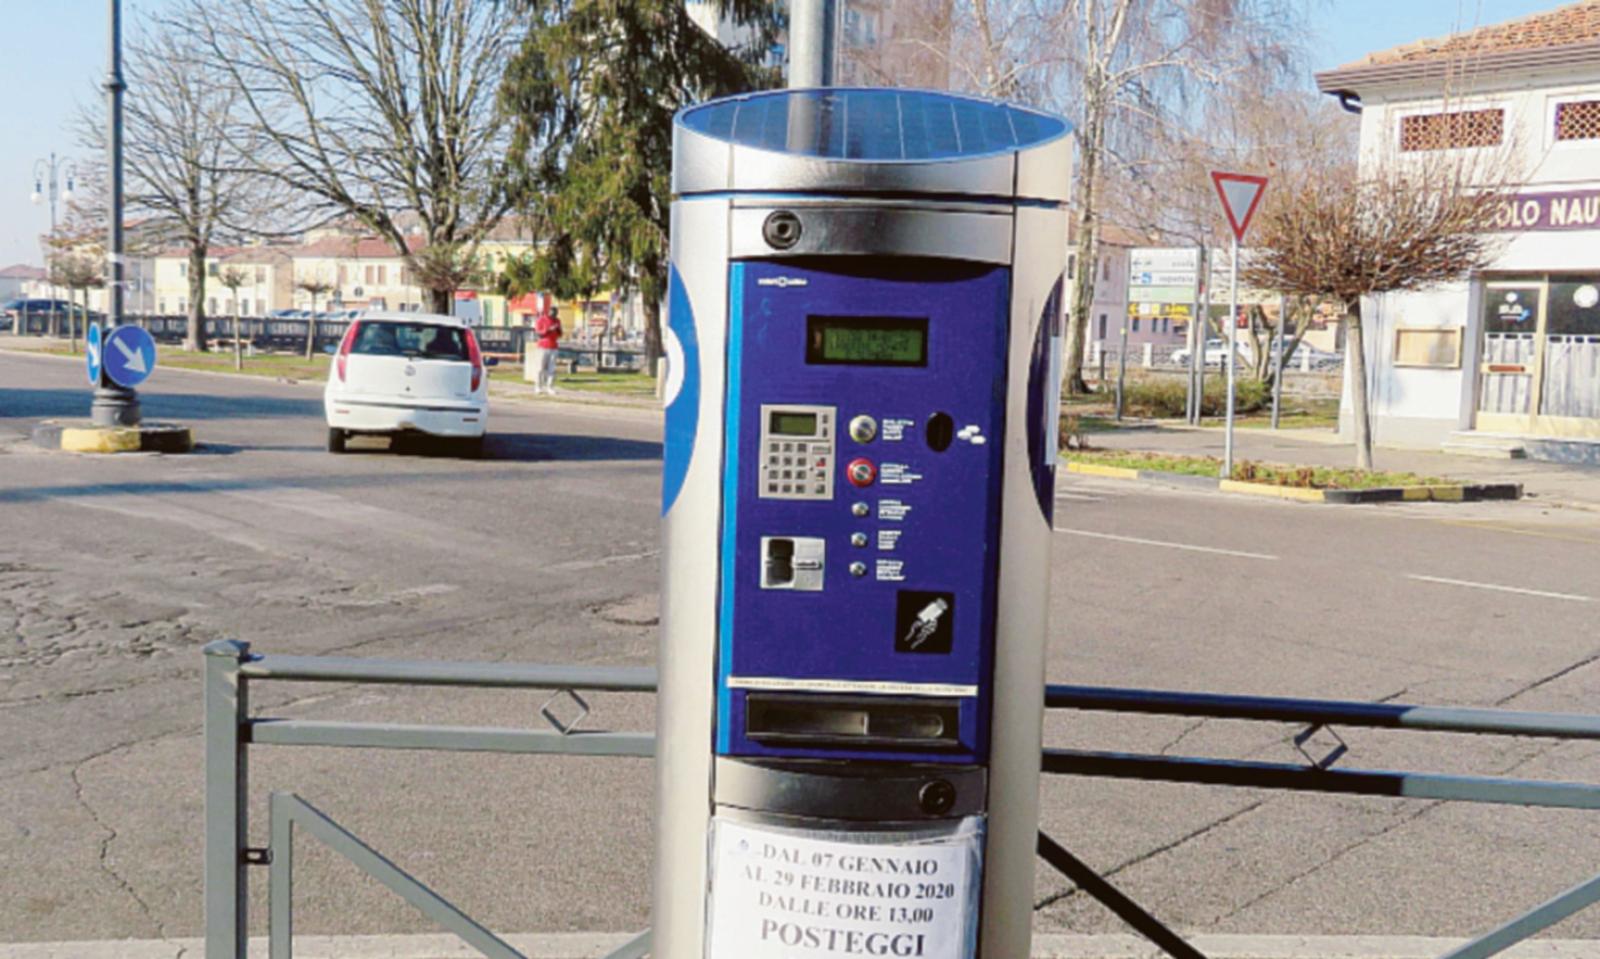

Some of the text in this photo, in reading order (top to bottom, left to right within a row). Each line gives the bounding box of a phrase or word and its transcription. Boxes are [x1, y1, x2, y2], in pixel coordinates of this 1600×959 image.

[763, 843, 938, 876] DAL 07 GENNAIO
[740, 864, 955, 899] AL 29 FEBBRAIO 2020
[759, 891, 934, 924] DALLE ORE 13,00
[761, 918, 926, 957] POSTEGGI
